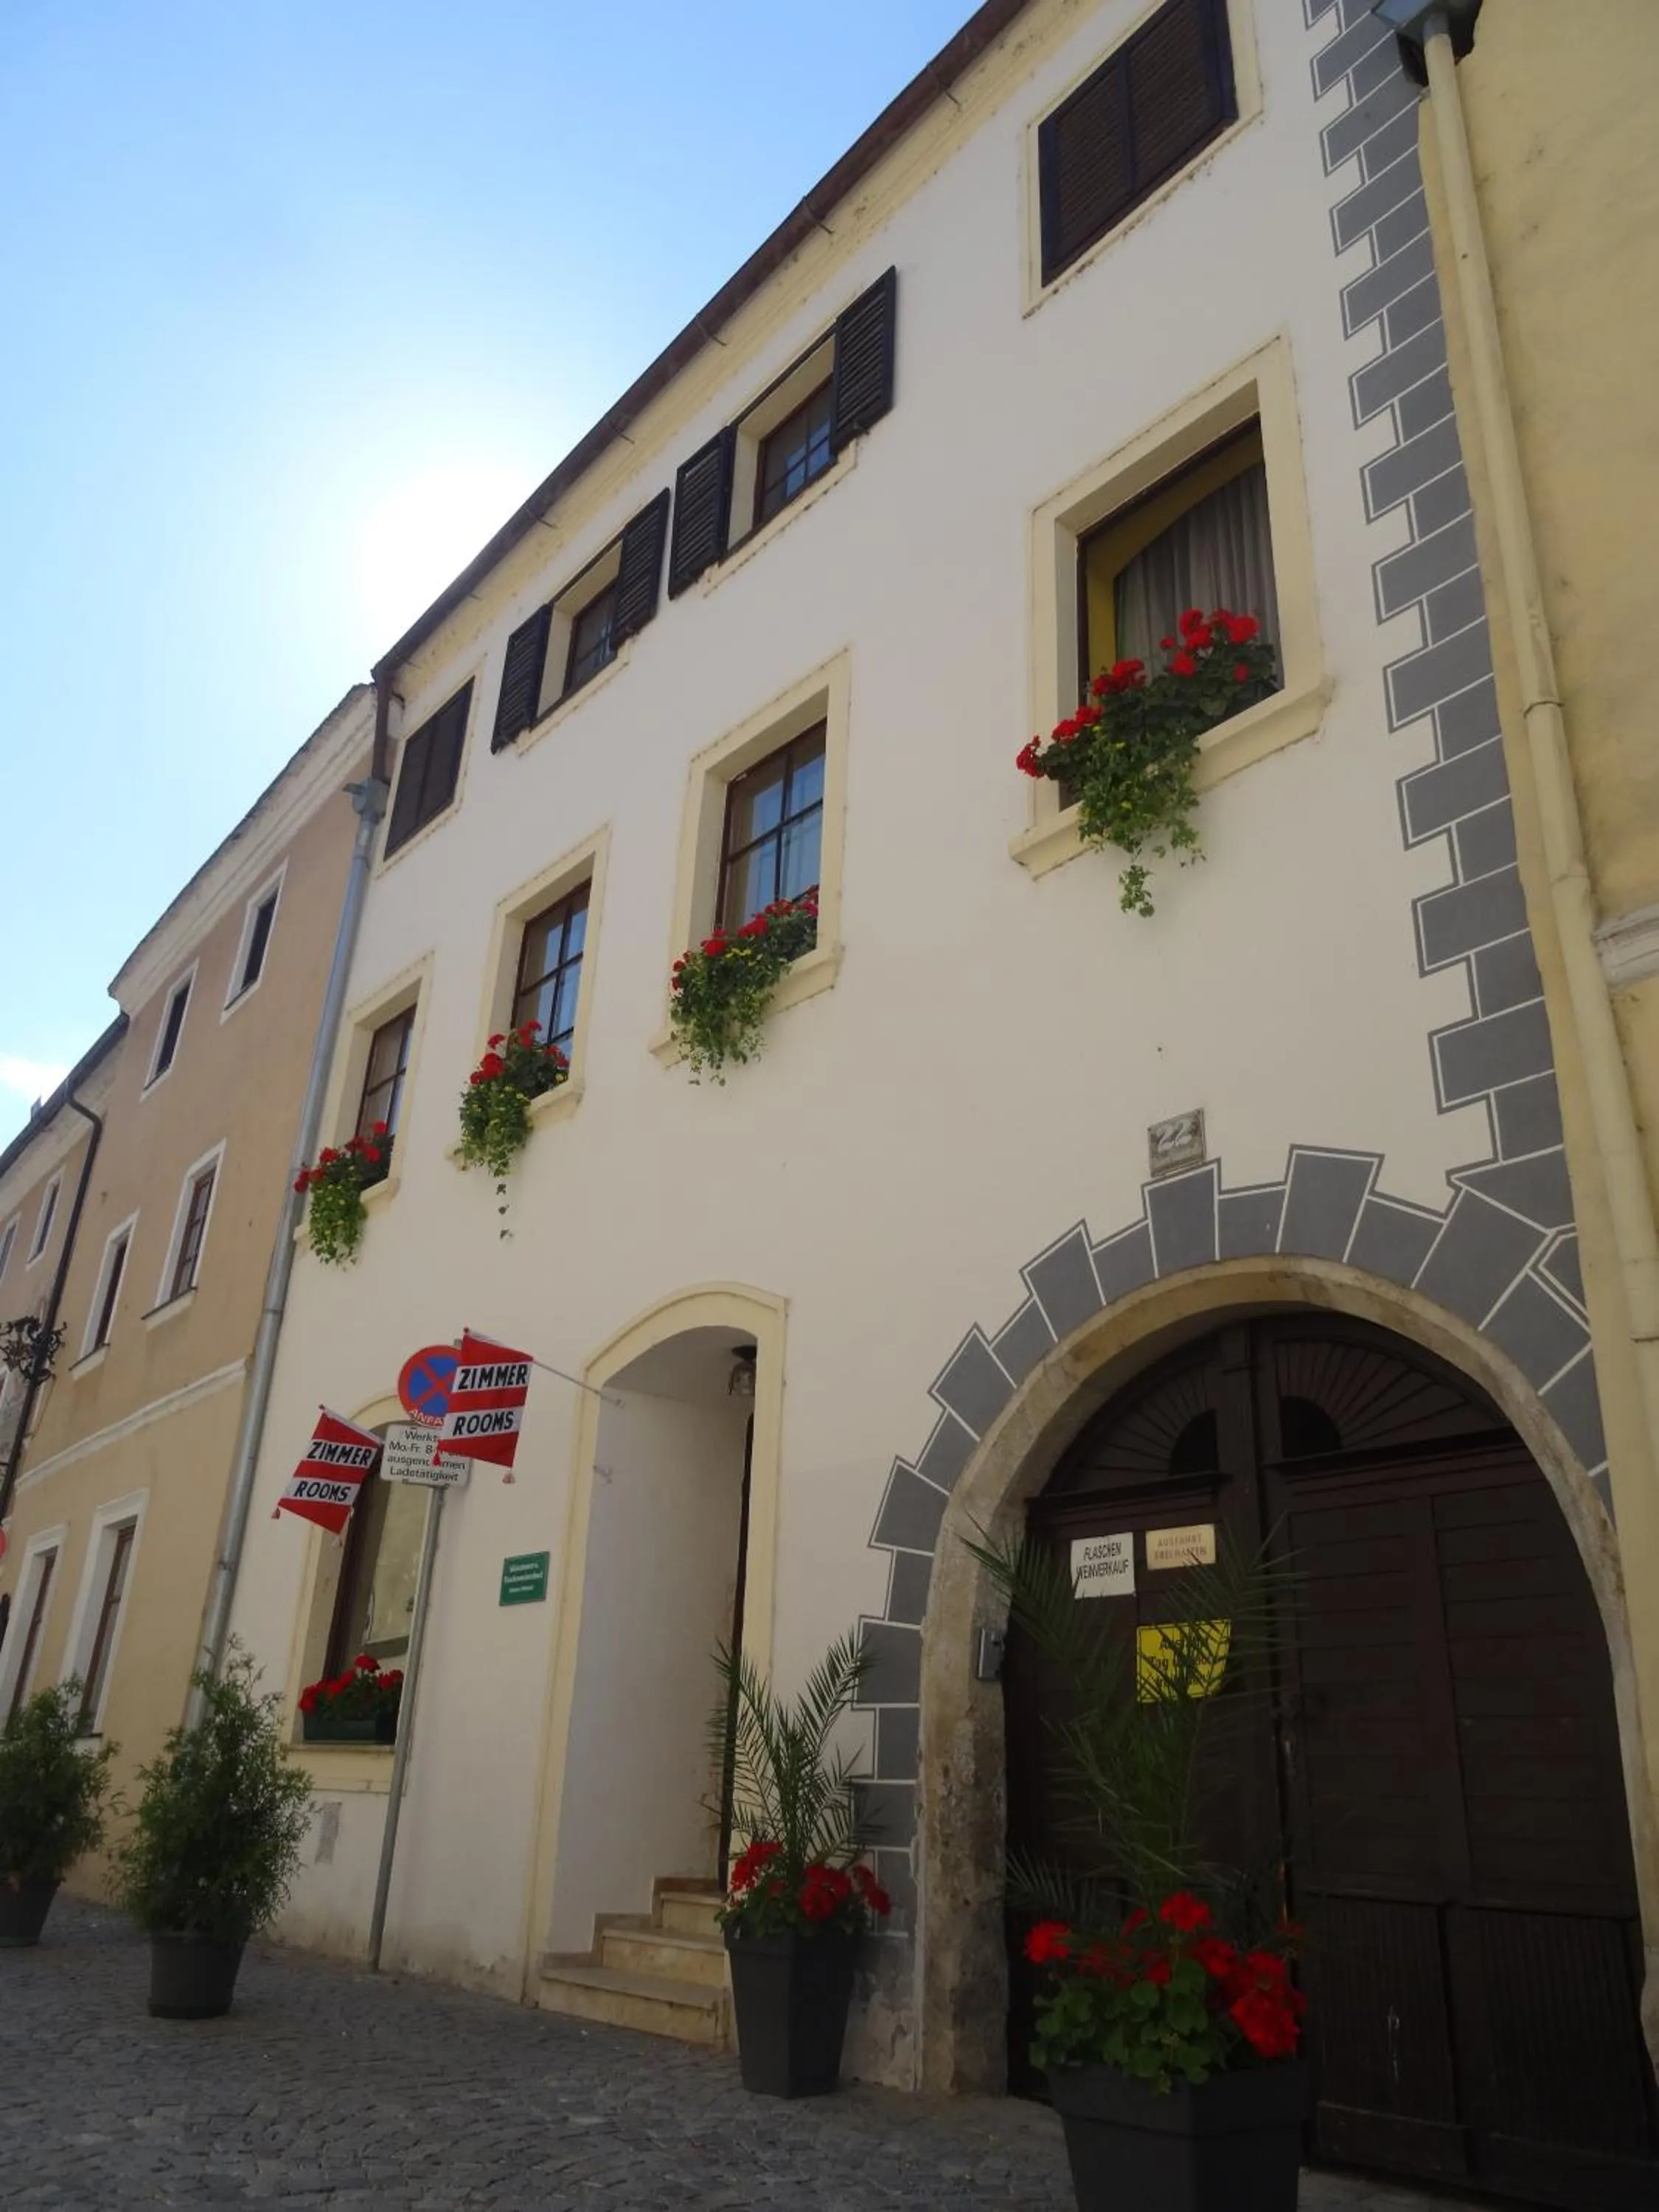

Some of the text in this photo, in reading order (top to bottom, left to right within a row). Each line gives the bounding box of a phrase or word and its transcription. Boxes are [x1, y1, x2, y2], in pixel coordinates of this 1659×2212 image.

[1156, 1120, 1192, 1152] 22
[457, 1364, 528, 1391] ZIMMER
[452, 1411, 515, 1436] ROOMS
[306, 1441, 372, 1467] ZIMMER
[293, 1480, 352, 1502] ROOMS
[1083, 1542, 1122, 1561] FLASCHEN
[1076, 1558, 1129, 1579] WEINVERKAUF
